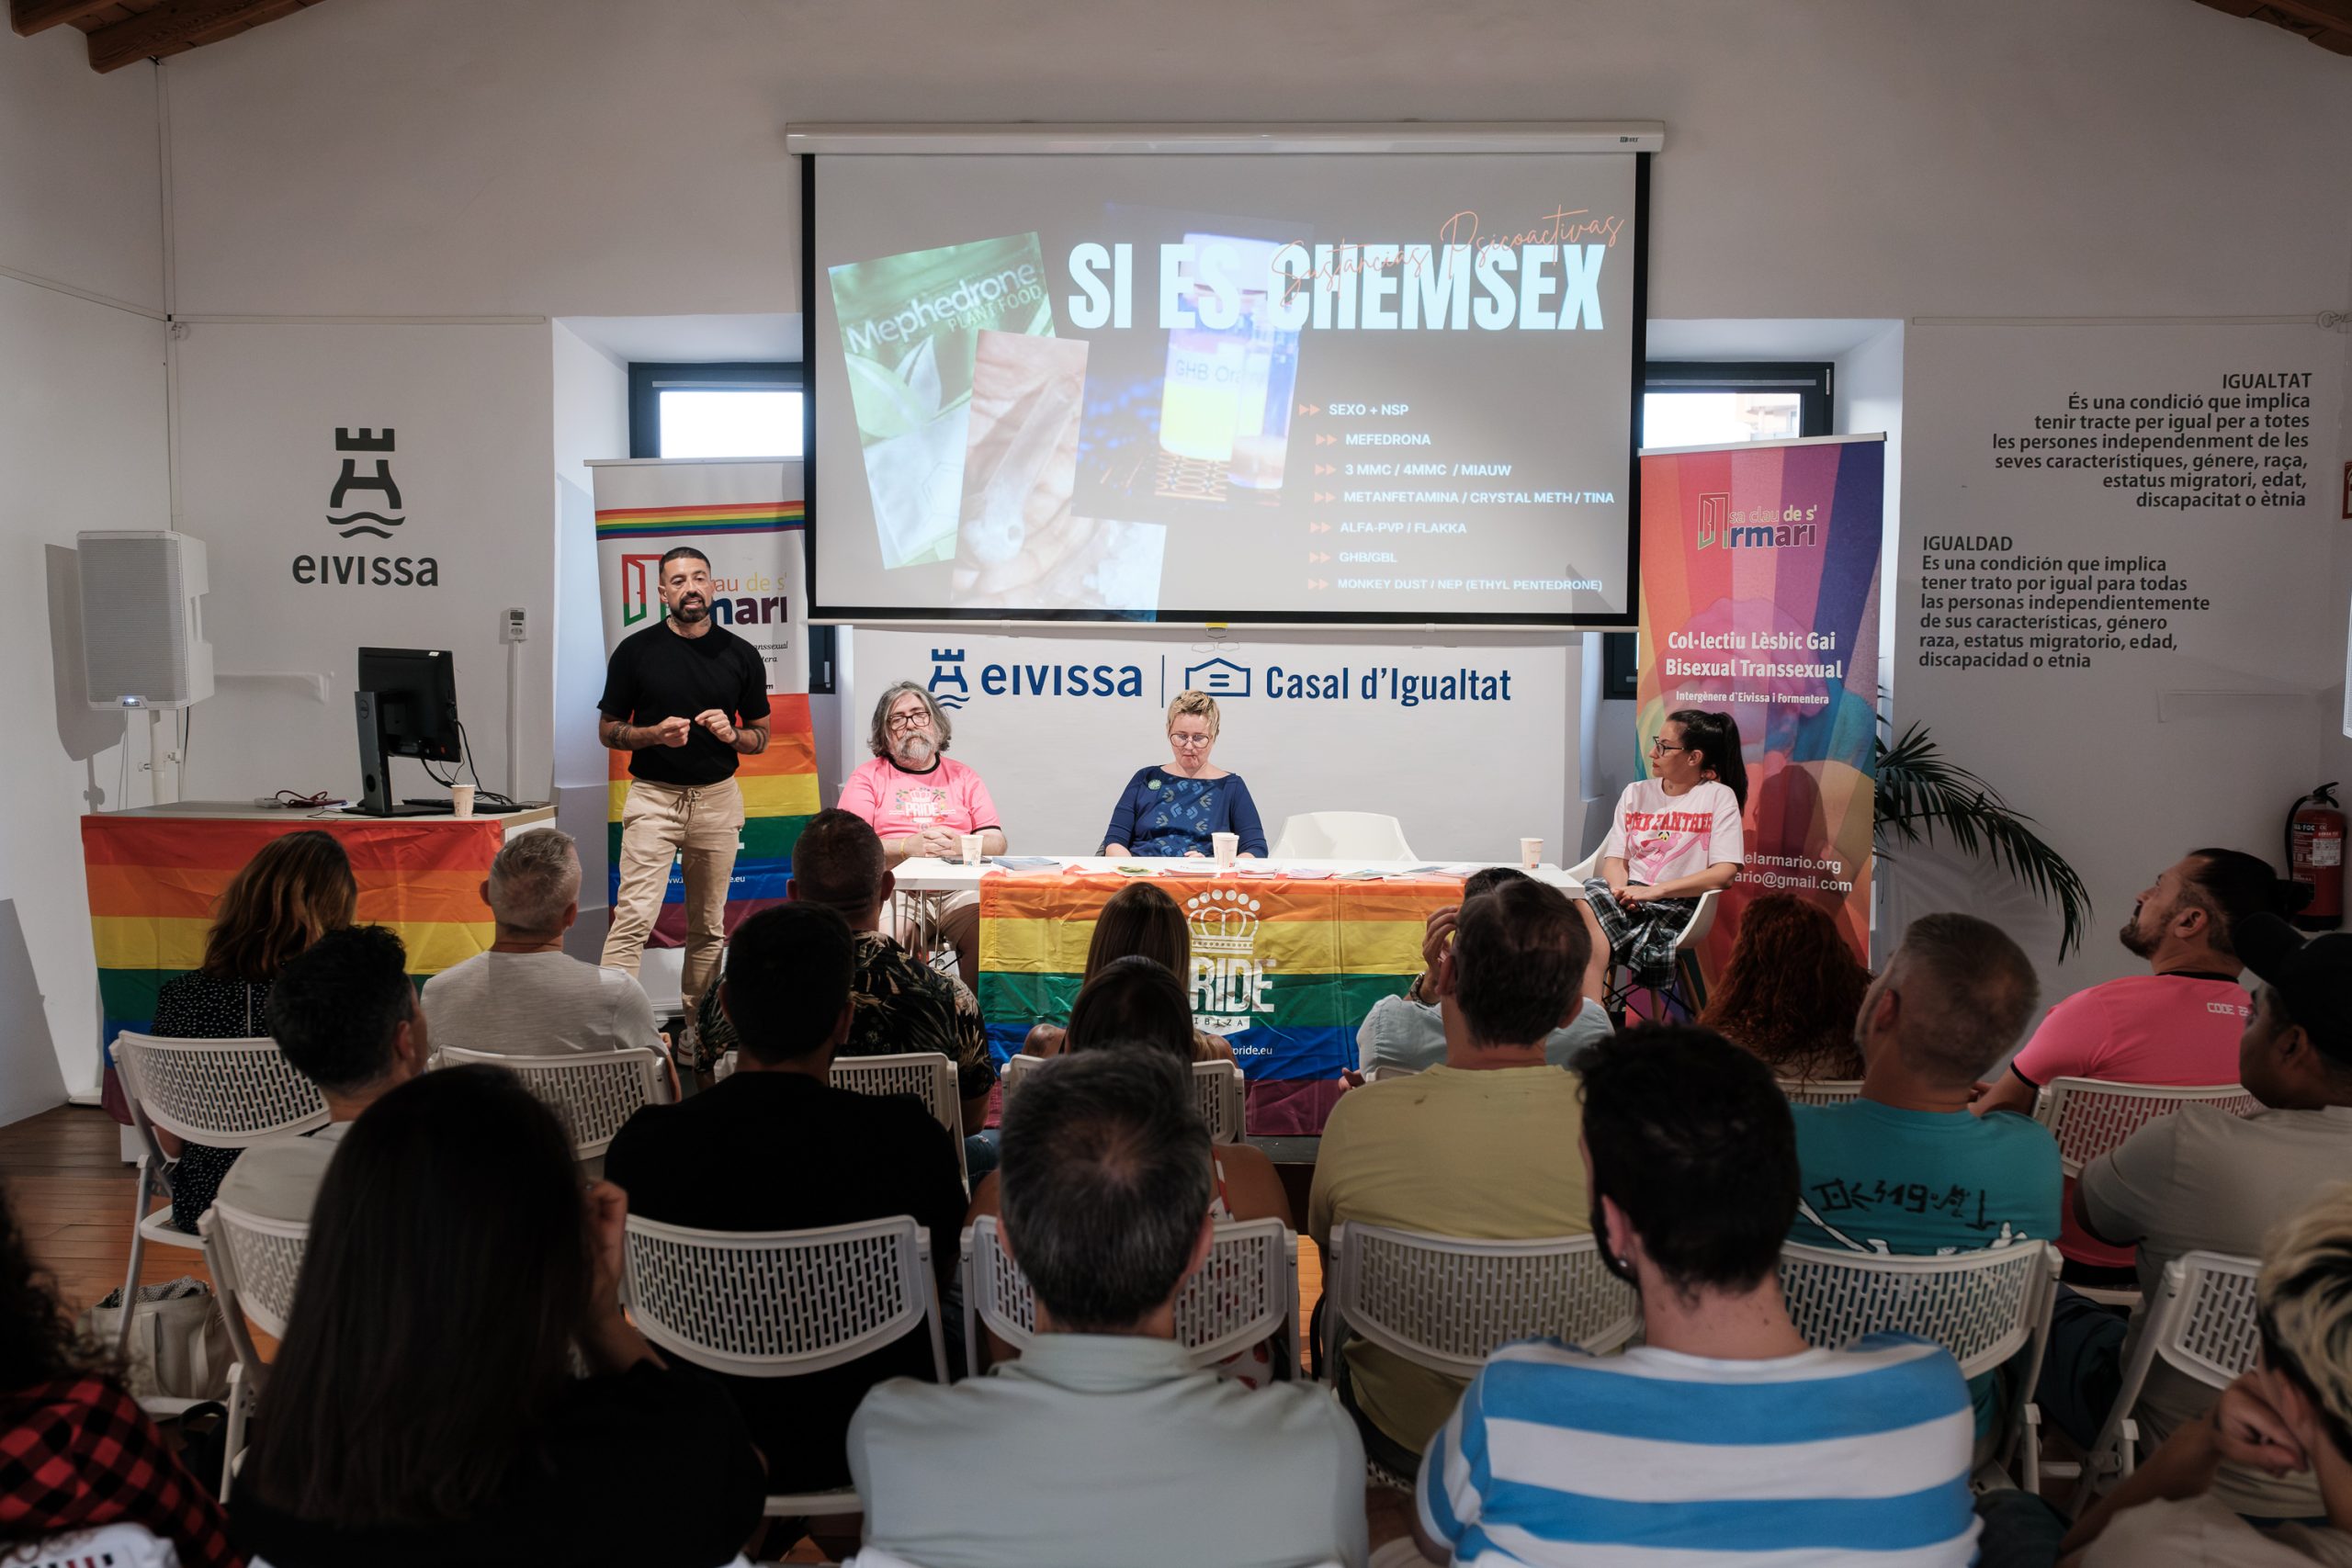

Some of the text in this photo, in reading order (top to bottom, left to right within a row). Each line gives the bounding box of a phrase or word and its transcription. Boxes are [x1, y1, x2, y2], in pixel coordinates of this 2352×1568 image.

[1069, 243, 1607, 330] SI ES CHEMSEX
[998, 284, 1042, 314] FOOD
[845, 264, 1038, 354] Mephedrone
[1176, 360, 1208, 381] GHB
[2222, 373, 2312, 389] IGUALTAT
[1329, 404, 1409, 415] SEXO + NSP
[2069, 392, 2310, 414] És una condició que implica
[2035, 413, 2310, 433] tenir tracte per igual per a totes
[1345, 434, 1431, 446] MEFEDRONA
[1994, 433, 2309, 452] les persones independenment de les
[1345, 464, 1353, 475] 3
[1357, 465, 1391, 476] MMC
[1403, 465, 1446, 476] 4MMC
[1462, 465, 1512, 476] MIAUW
[1996, 457, 2041, 468] seves
[2046, 454, 2188, 471] característiques,
[2264, 456, 2308, 471] raça,
[2103, 472, 2307, 491] estatus migratori, edat,
[1344, 491, 1459, 503] METANFETAMINA
[1470, 491, 1532, 503] CRYSTAL
[1534, 492, 1572, 503] METH
[1583, 492, 1614, 504] TINA
[2136, 491, 2305, 511] discapacitat o ètnia
[1730, 512, 1745, 523] sa
[1749, 506, 1779, 523] clau
[1783, 504, 1802, 522] de
[1340, 522, 1404, 533] ALFA-PVP
[1414, 523, 1467, 534] FLAKKA
[1923, 536, 2013, 551] IGUALDAD
[1339, 552, 1397, 563] GHB/GBL
[1922, 556, 2166, 575] Es una condición que implica
[292, 555, 438, 586] eivissa
[746, 572, 770, 592] de
[1338, 579, 1390, 589] MONKEY
[1395, 579, 1428, 590] DUST
[1438, 580, 1463, 590] NEP
[1466, 579, 1510, 592] (ETHYL
[1513, 580, 1602, 592] PENTEDRONE)
[1921, 575, 2187, 594] tener trato por igual para todas
[1921, 594, 2210, 614] las personas independientemente
[1920, 613, 2167, 633] de sus características, género
[1751, 631, 1803, 650] Lèsbic
[1806, 632, 1835, 650] Gai
[1919, 634, 2177, 652] raza, estatus migratorio, edad,
[1666, 659, 1843, 679] Bisexual Transsexual
[1918, 652, 2091, 671] discapacidad o etnia
[980, 663, 1511, 707] eivissa Casal d'Igualtat
[1676, 691, 1727, 703] Intergènere
[1778, 694, 1829, 705] Formentera
[905, 803, 939, 817] PRIDE
[1745, 852, 1841, 874] elarmario.org
[1735, 871, 1852, 892] ario@gmail.com
[1189, 957, 1276, 1012] RIDE
[1194, 1017, 1243, 1027] IBIZA
